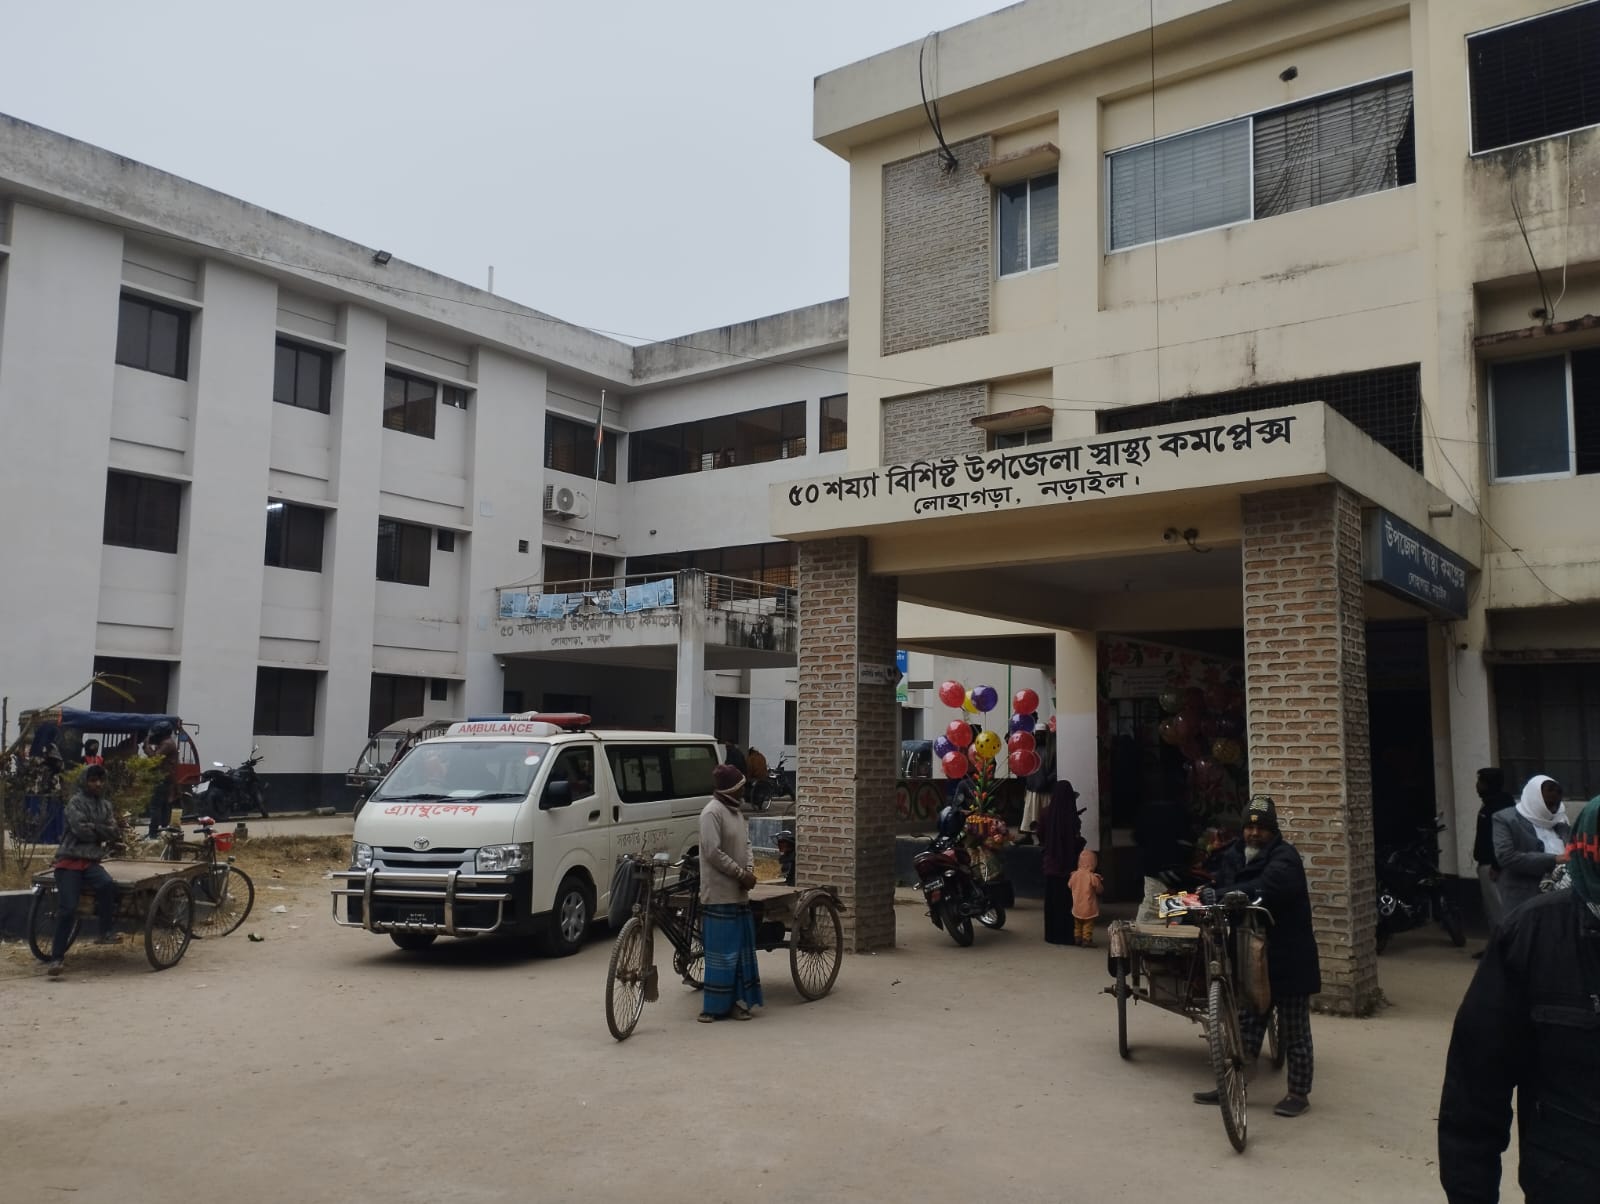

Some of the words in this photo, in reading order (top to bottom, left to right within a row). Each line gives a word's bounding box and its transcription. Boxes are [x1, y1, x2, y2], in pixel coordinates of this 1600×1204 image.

[788, 484, 819, 506] ৫০
[823, 471, 879, 501] শয্যা
[885, 458, 958, 495] বিশিষ্ট
[963, 445, 1082, 483] উপজেলা
[1087, 436, 1152, 467] স্বাস্থ্য
[1157, 416, 1297, 458] কমপ্লেক্স
[914, 486, 1021, 514] লোহাগড়া,
[458, 723, 534, 733] AMBULANCE
